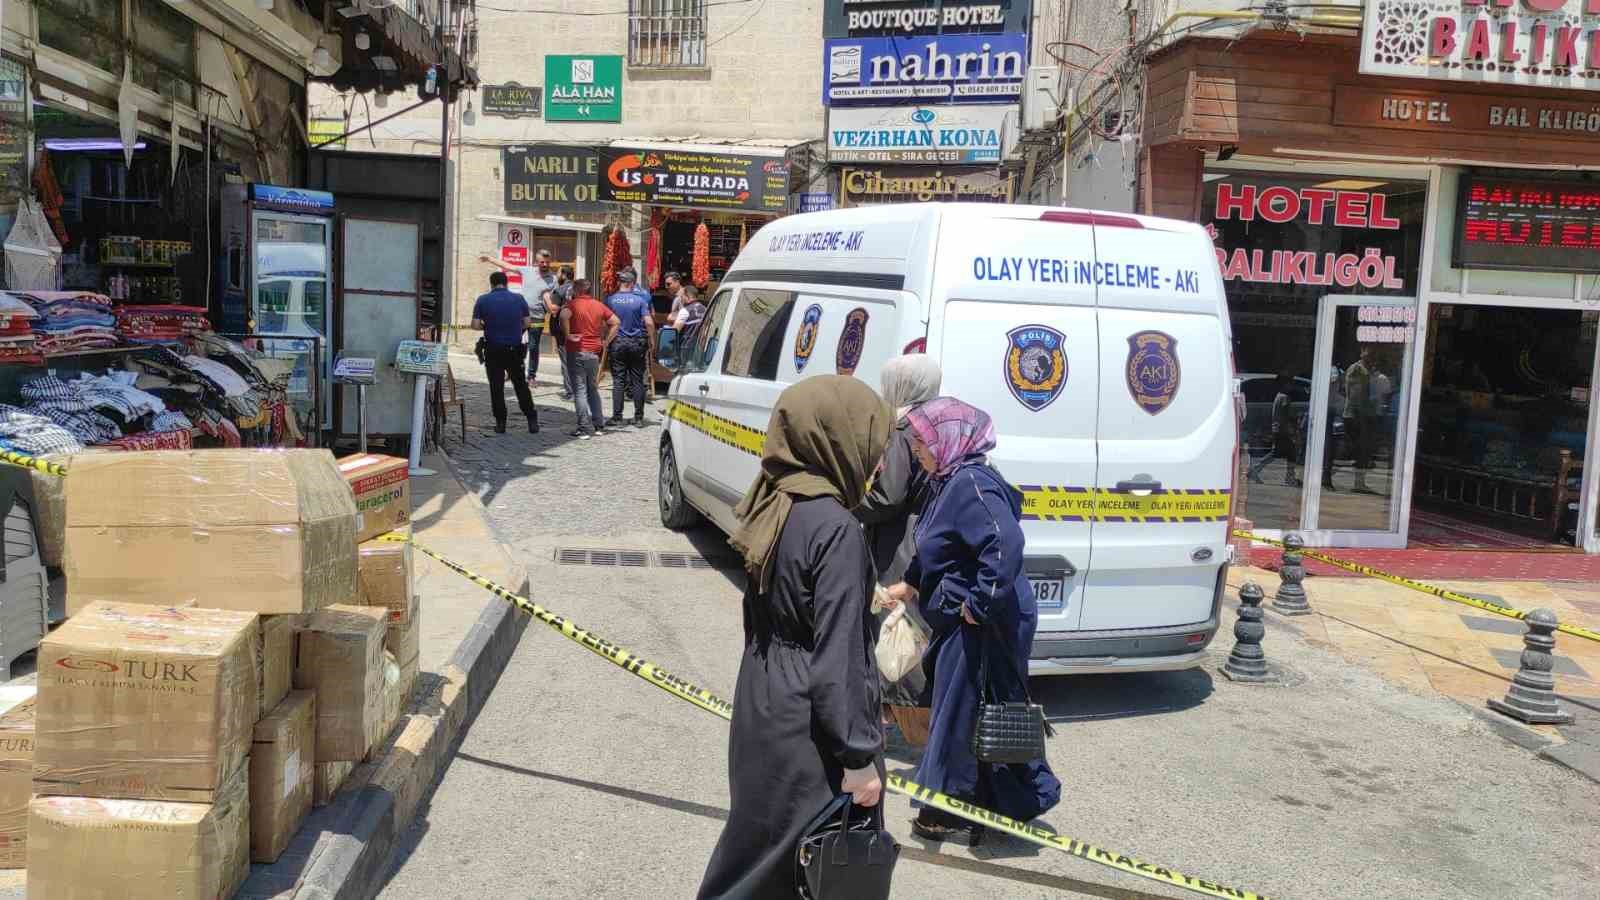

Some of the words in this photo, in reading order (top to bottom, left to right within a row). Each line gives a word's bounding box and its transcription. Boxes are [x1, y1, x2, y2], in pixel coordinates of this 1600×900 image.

[849, 8, 938, 31] BOUTIQUE
[942, 5, 1004, 27] HOTEL
[871, 42, 1023, 82] nahrin
[583, 86, 615, 98] HAN
[1383, 98, 1451, 123] HOTEL
[524, 156, 579, 174] NARLI
[868, 151, 892, 160] OTEL
[675, 174, 749, 190] BURADA
[846, 171, 955, 201] Cihangir
[1215, 183, 1400, 230] HOTEL
[973, 257, 1023, 281] OLAY
[1049, 499, 1073, 508] OLAY
[1151, 501, 1171, 510] OLAY
[1034, 582, 1059, 600] 187
